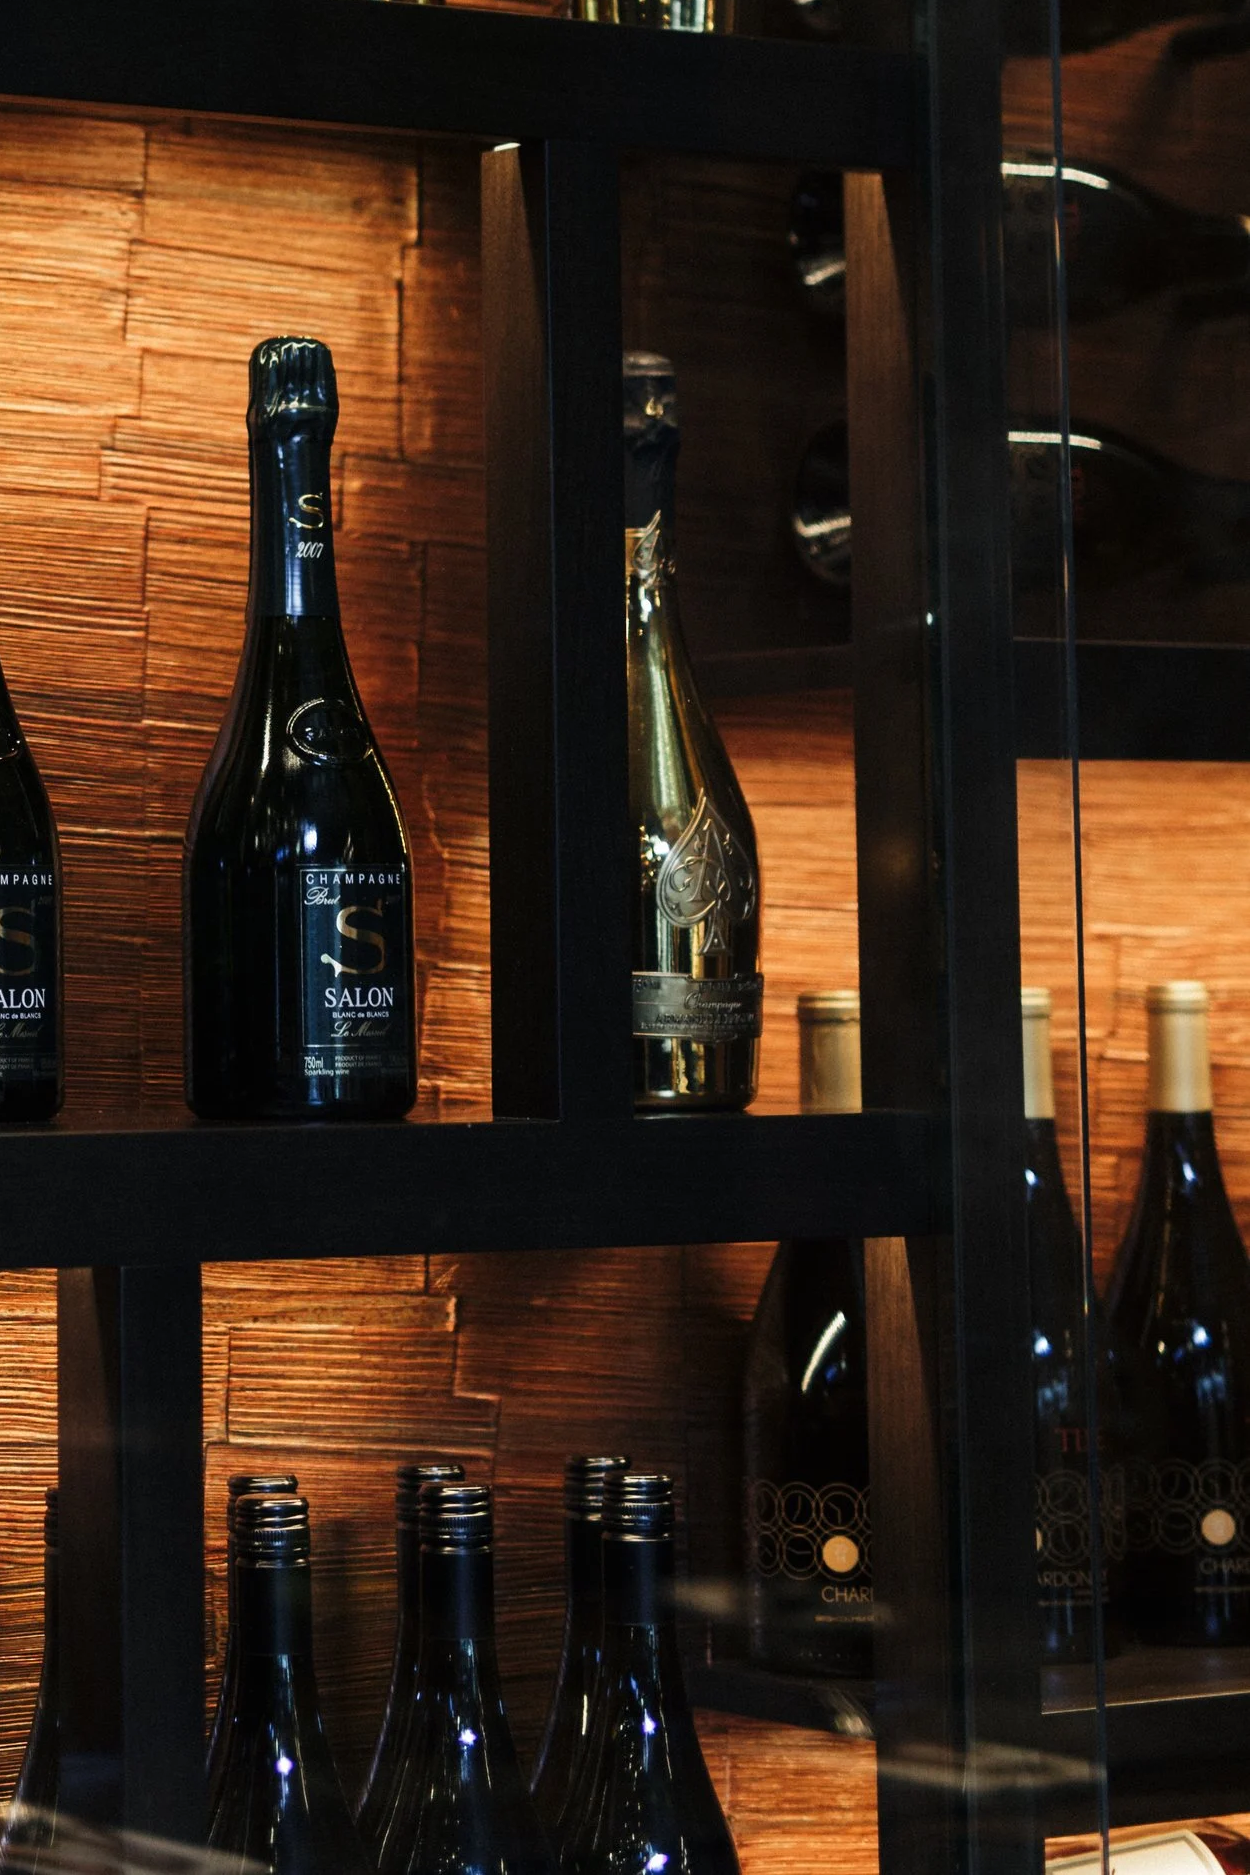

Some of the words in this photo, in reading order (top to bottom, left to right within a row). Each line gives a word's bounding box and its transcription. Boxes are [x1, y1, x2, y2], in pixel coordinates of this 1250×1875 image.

[289, 492, 324, 529] S
[295, 541, 324, 558] 2007
[306, 873, 400, 885] CHAMPAGNE
[304, 886, 341, 905] Brut
[320, 898, 386, 978] S
[324, 987, 394, 1008] SALON
[332, 1011, 356, 1019] BLANC
[304, 1056, 324, 1069] 750ml
[304, 1068, 334, 1077] Sparkling
[821, 1585, 874, 1604] CHAR
